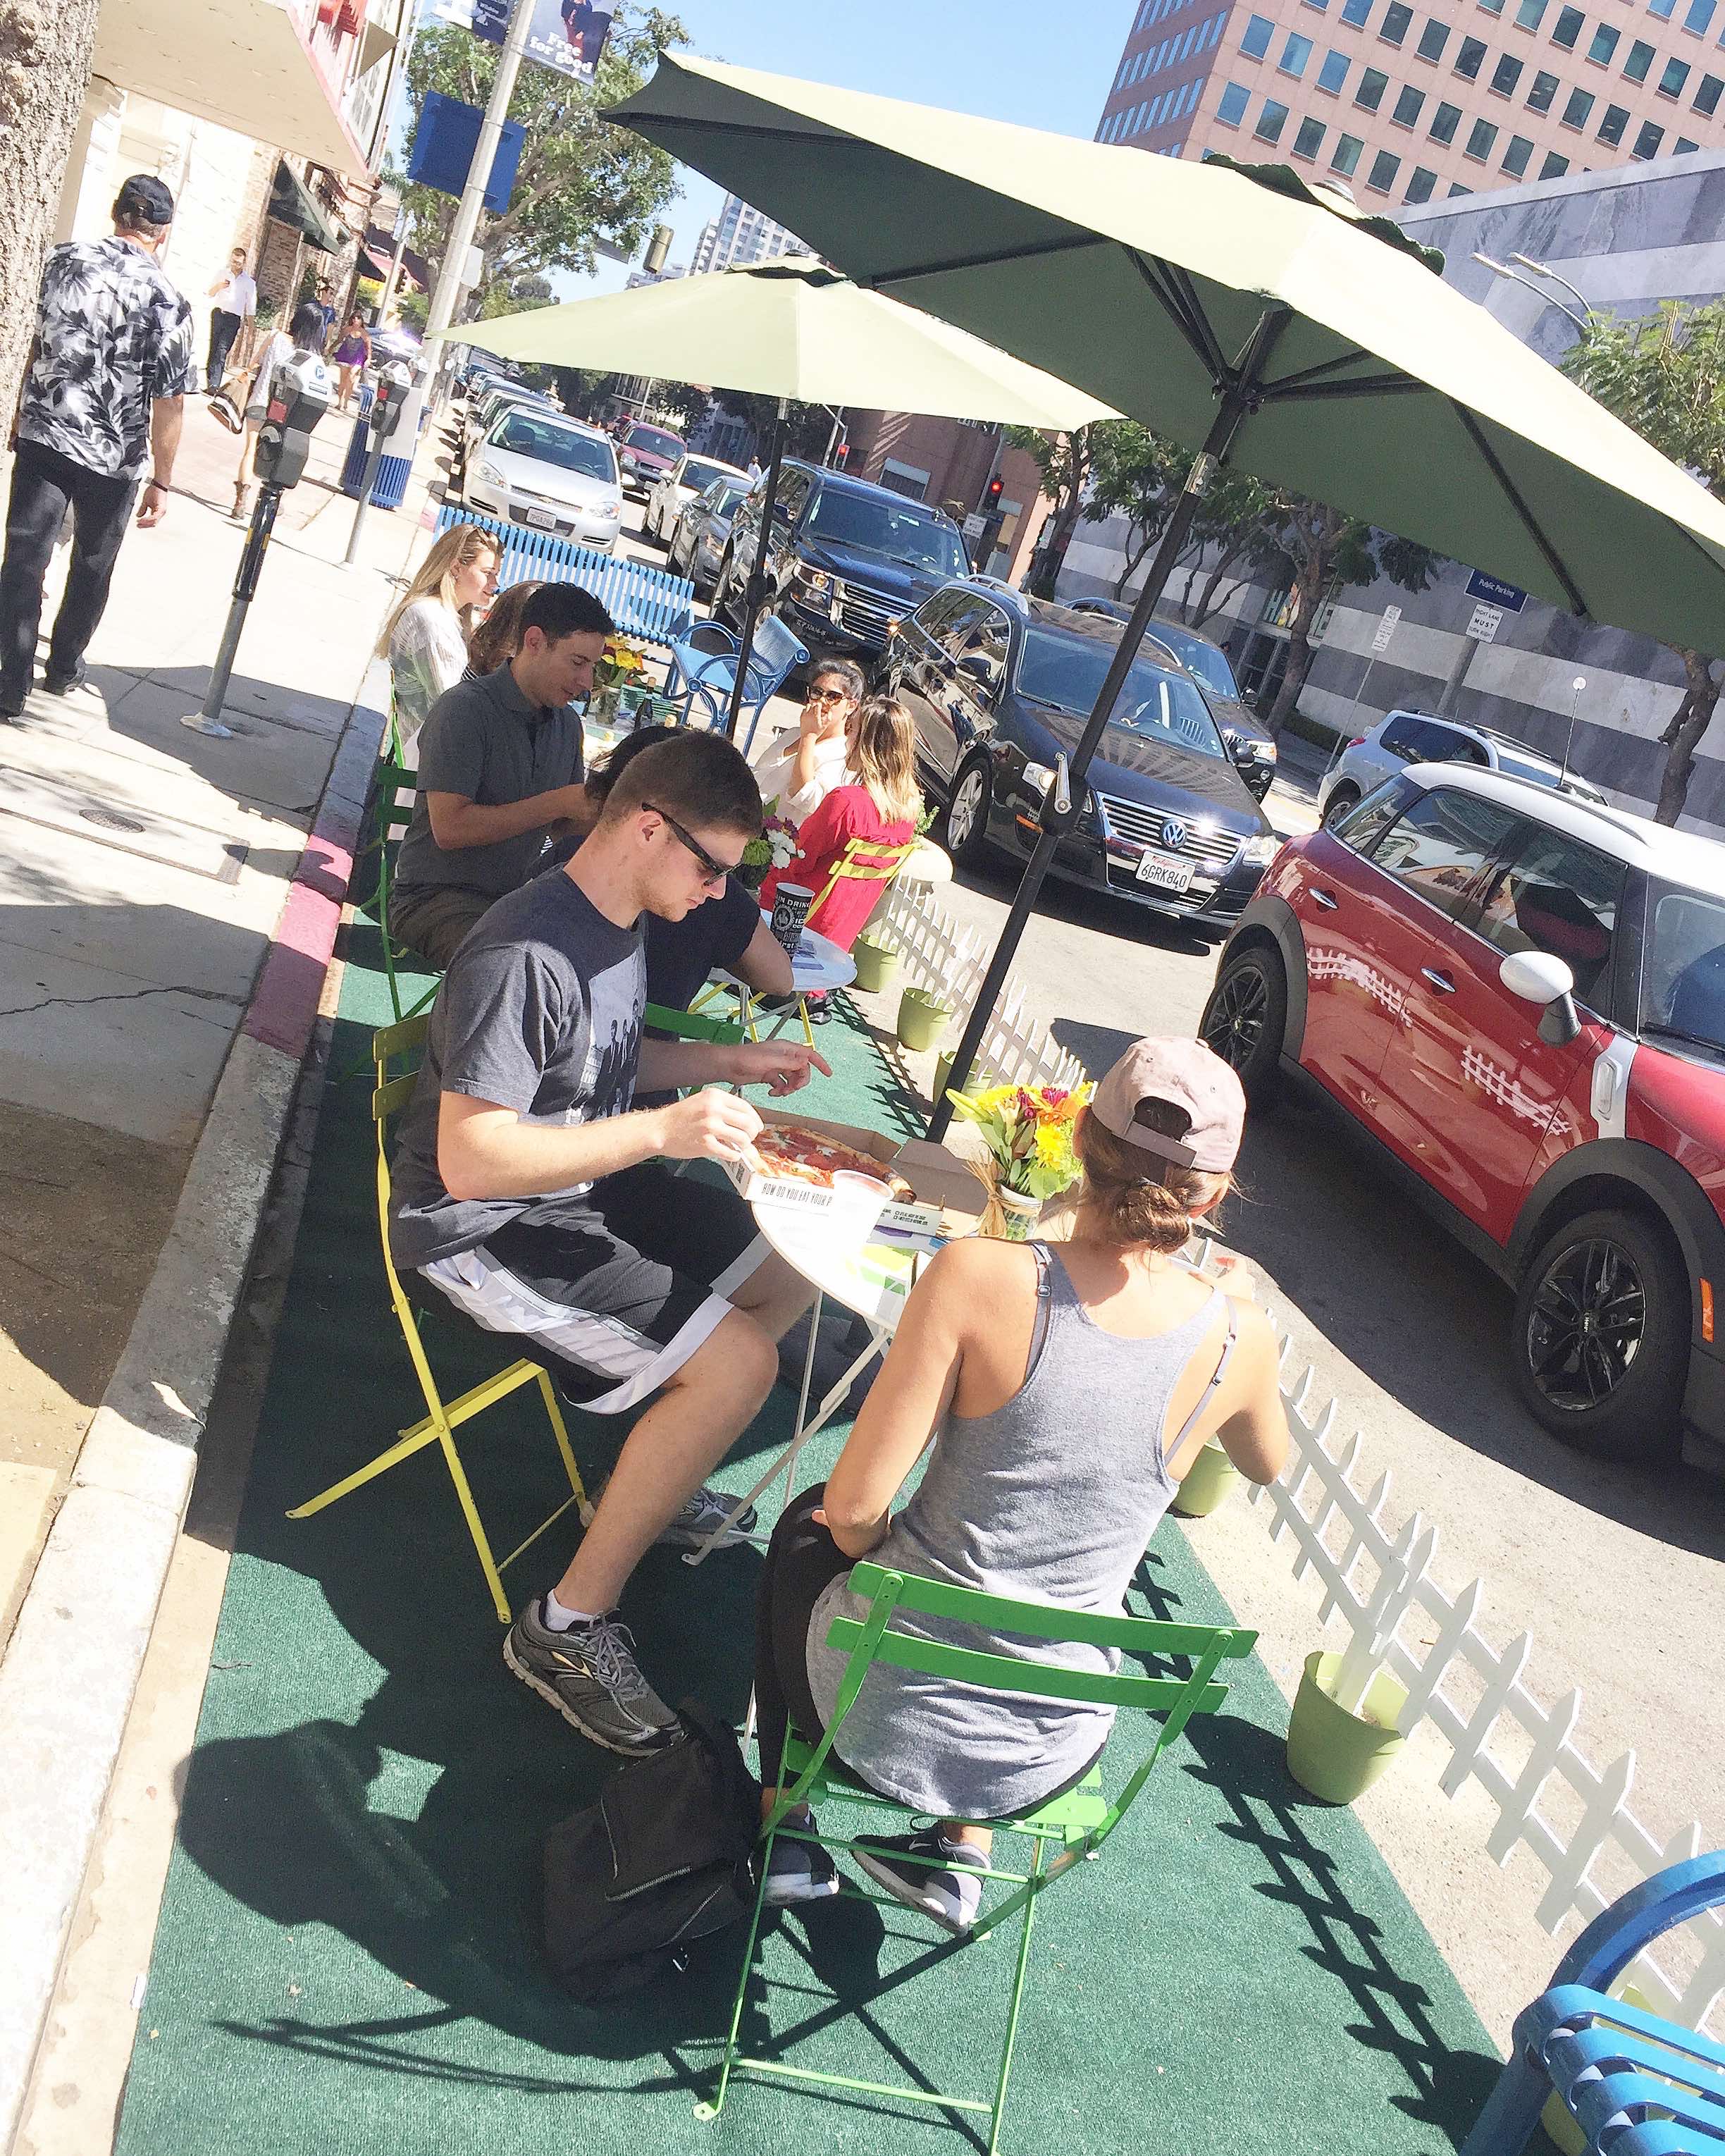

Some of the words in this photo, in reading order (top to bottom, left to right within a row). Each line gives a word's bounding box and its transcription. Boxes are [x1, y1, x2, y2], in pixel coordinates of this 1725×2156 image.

[530, 35, 553, 56] for
[555, 51, 593, 74] good
[547, 32, 582, 56] Free
[1479, 579, 1495, 590] Public
[1495, 585, 1515, 598] Parking
[1474, 618, 1494, 629] MUST
[1142, 863, 1187, 888] 6GRK840
[777, 1185, 786, 1198] DO
[786, 1188, 798, 1201] YOU
[798, 1190, 810, 1202] EAT
[810, 1192, 827, 1206] YOUR
